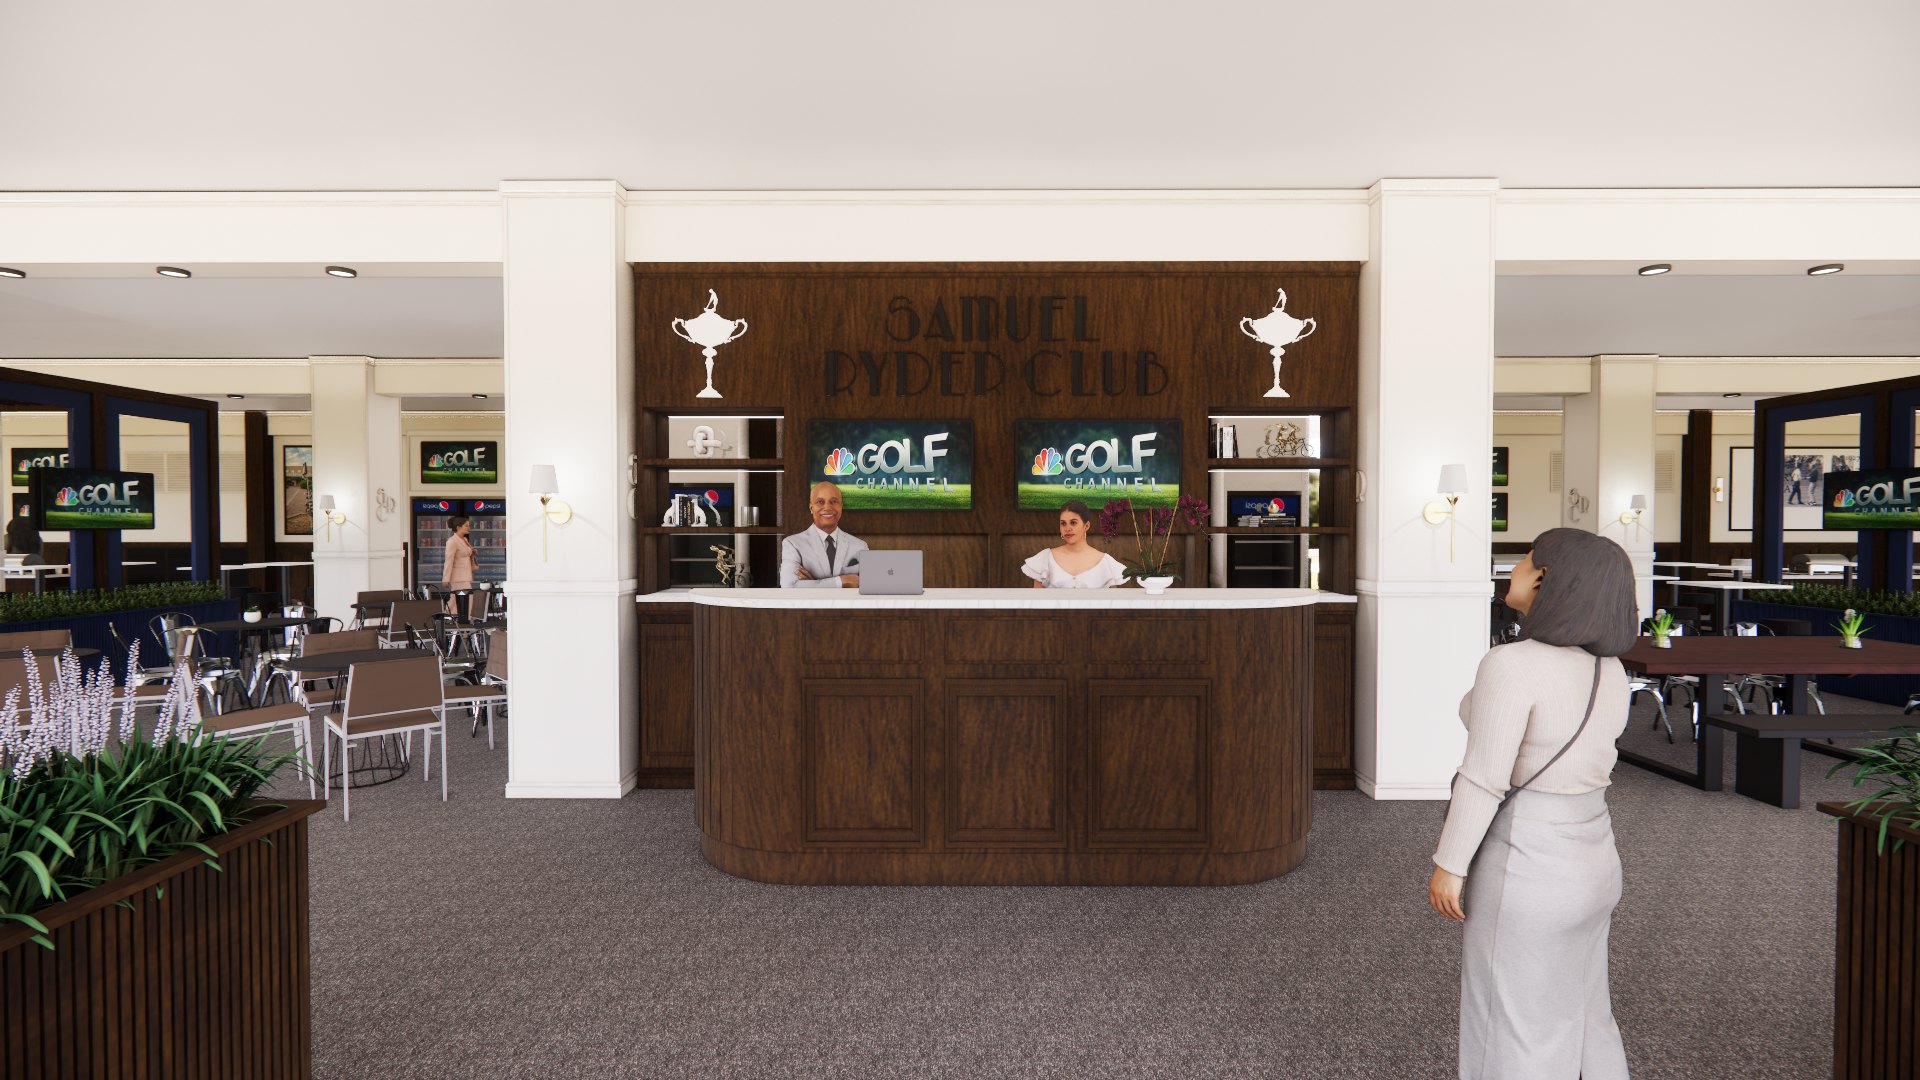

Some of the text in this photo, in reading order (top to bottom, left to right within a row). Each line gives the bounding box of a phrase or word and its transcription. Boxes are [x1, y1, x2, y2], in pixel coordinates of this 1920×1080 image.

[885, 296, 1100, 342] SAMUEL
[824, 351, 1169, 397] RYDER CLUB
[444, 447, 486, 466] GOLF
[857, 432, 949, 474] GOLF
[1065, 432, 1157, 474] GOLF
[79, 481, 139, 506] GOLF
[856, 477, 954, 492] CHANNEL
[1063, 477, 1162, 492] CHANNEL
[1856, 477, 1920, 506] GOLF
[79, 507, 142, 519] CHANNEL
